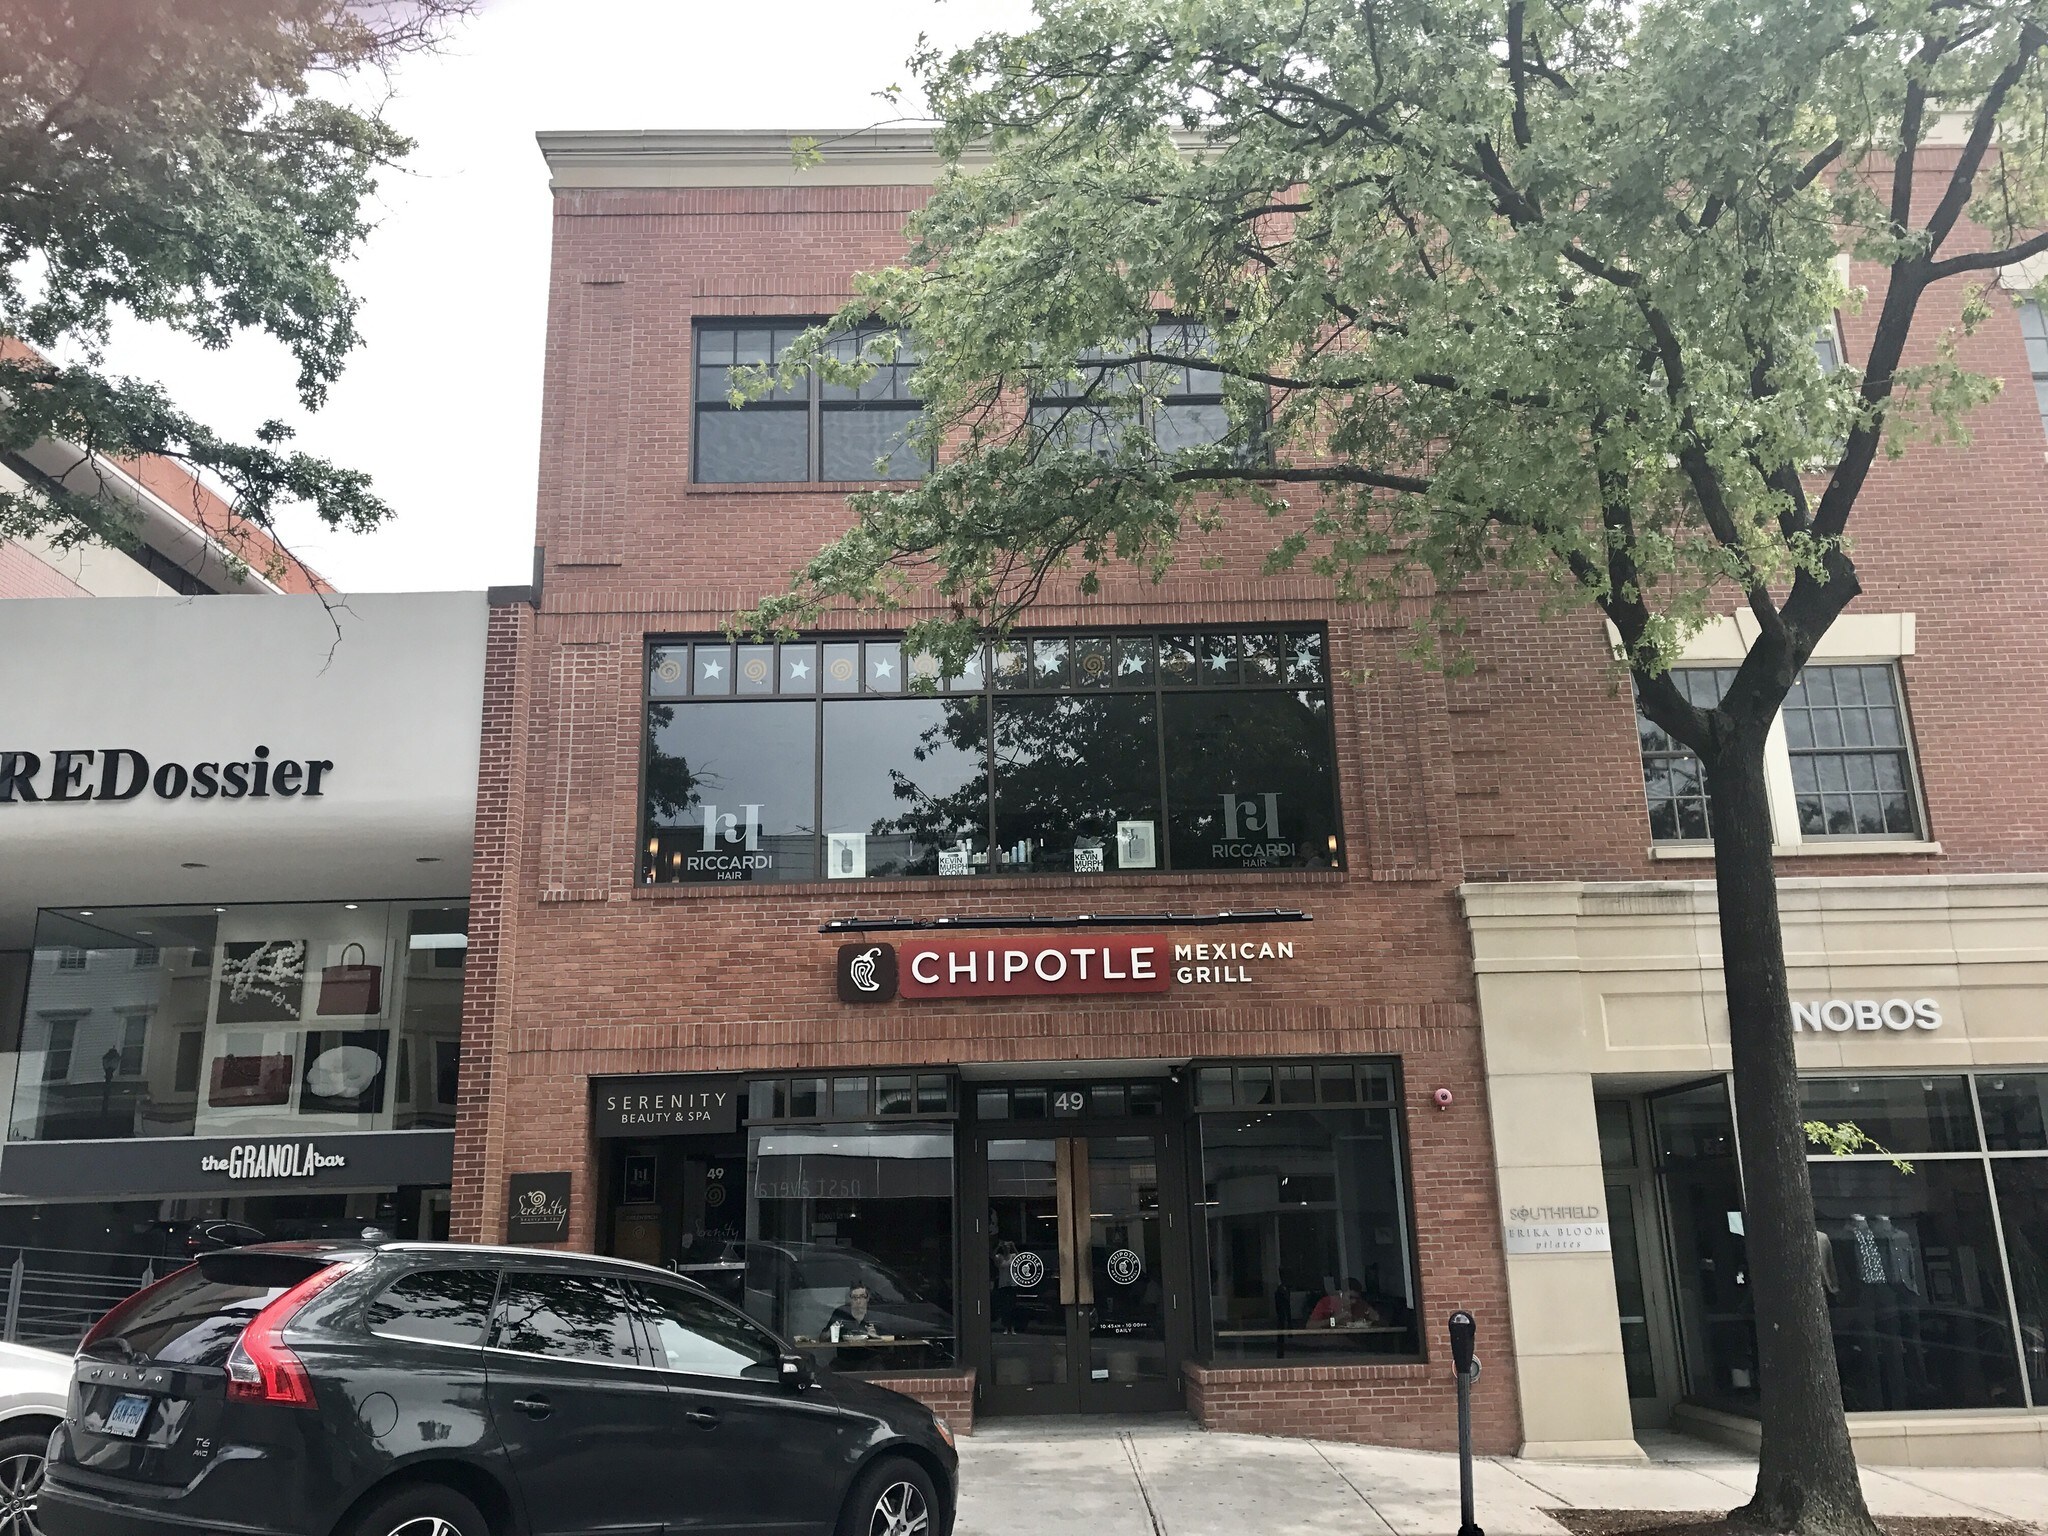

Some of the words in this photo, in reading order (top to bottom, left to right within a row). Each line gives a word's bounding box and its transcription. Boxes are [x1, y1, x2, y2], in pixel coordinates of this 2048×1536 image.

[0, 745, 334, 803] REDossier
[1212, 843, 1296, 858] RICCARDI
[687, 855, 773, 871] RICCARDI
[1242, 859, 1267, 868] HAIR
[717, 871, 742, 880] HAIR
[1174, 941, 1294, 961] MEXICAN
[911, 946, 1157, 984] CHIPOTLE
[1175, 965, 1253, 984] GRILL
[1790, 998, 1943, 1032] NOBOS
[607, 1092, 727, 1111] SERENITY
[1055, 1092, 1084, 1110] 49
[621, 1112, 671, 1124] BEAUTY
[675, 1112, 684, 1121] &
[688, 1111, 711, 1121] SPA
[707, 1167, 725, 1180] 49
[511, 1195, 567, 1232] Serenity
[1509, 1205, 1599, 1221] SOUTHFIELD
[1508, 1228, 1550, 1238] ERIKA
[1557, 1227, 1605, 1236] BLOOM
[1536, 1240, 1582, 1249] pilates
[1013, 1254, 1041, 1268] CHIPOTLE
[1110, 1251, 1138, 1265] CHIPOTLE
[195, 1437, 211, 1448] T6
